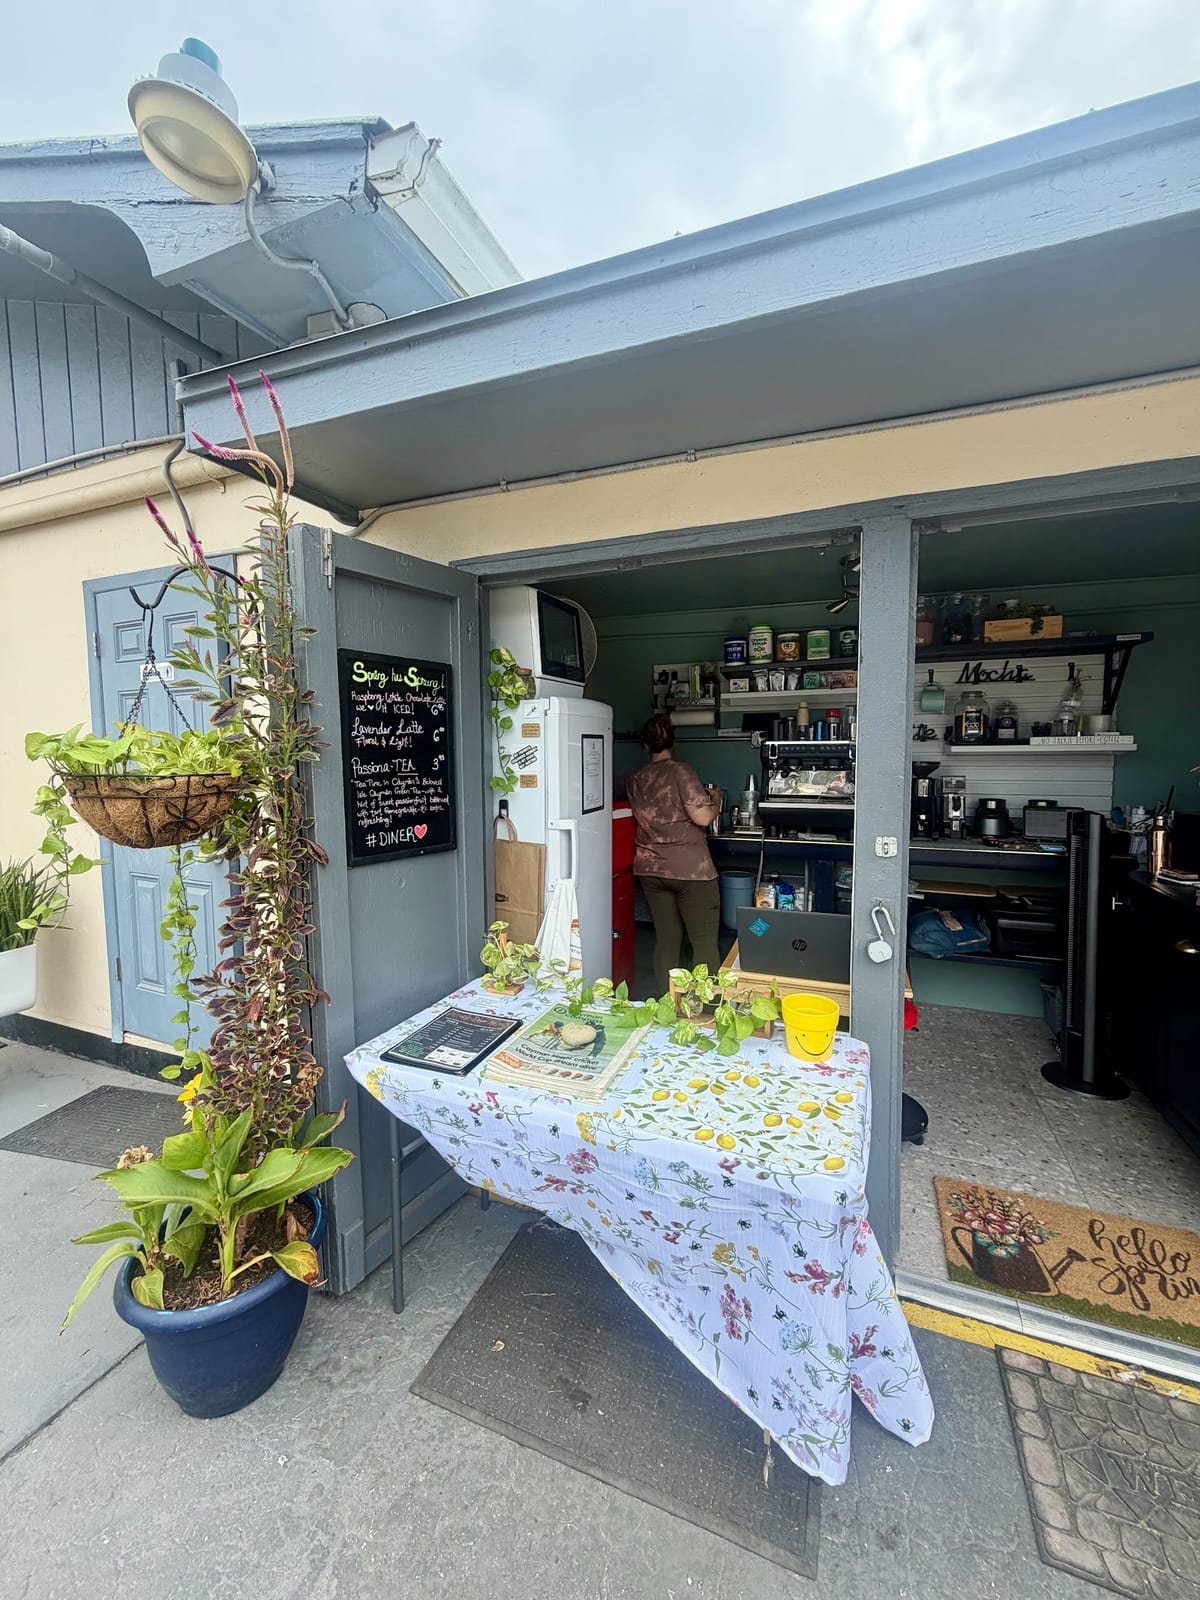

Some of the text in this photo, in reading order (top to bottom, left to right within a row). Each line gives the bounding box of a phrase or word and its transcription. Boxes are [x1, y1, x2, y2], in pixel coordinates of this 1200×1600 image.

[352, 661, 389, 688] Spring
[393, 703, 414, 715] ICED!
[351, 717, 424, 736] Lavender Latte
[355, 734, 379, 748] Floral
[389, 735, 412, 750] Light!
[357, 814, 392, 828] refreshing!
[364, 826, 417, 848] #DINER
[792, 939, 808, 952] hp
[515, 1046, 537, 1060] World
[537, 1055, 553, 1064] Cup
[553, 1059, 578, 1068] dream
[578, 1063, 598, 1071] alive
[521, 1043, 551, 1058] Cayman
[573, 1056, 600, 1066] cricket
[1088, 1218, 1191, 1276] hello
